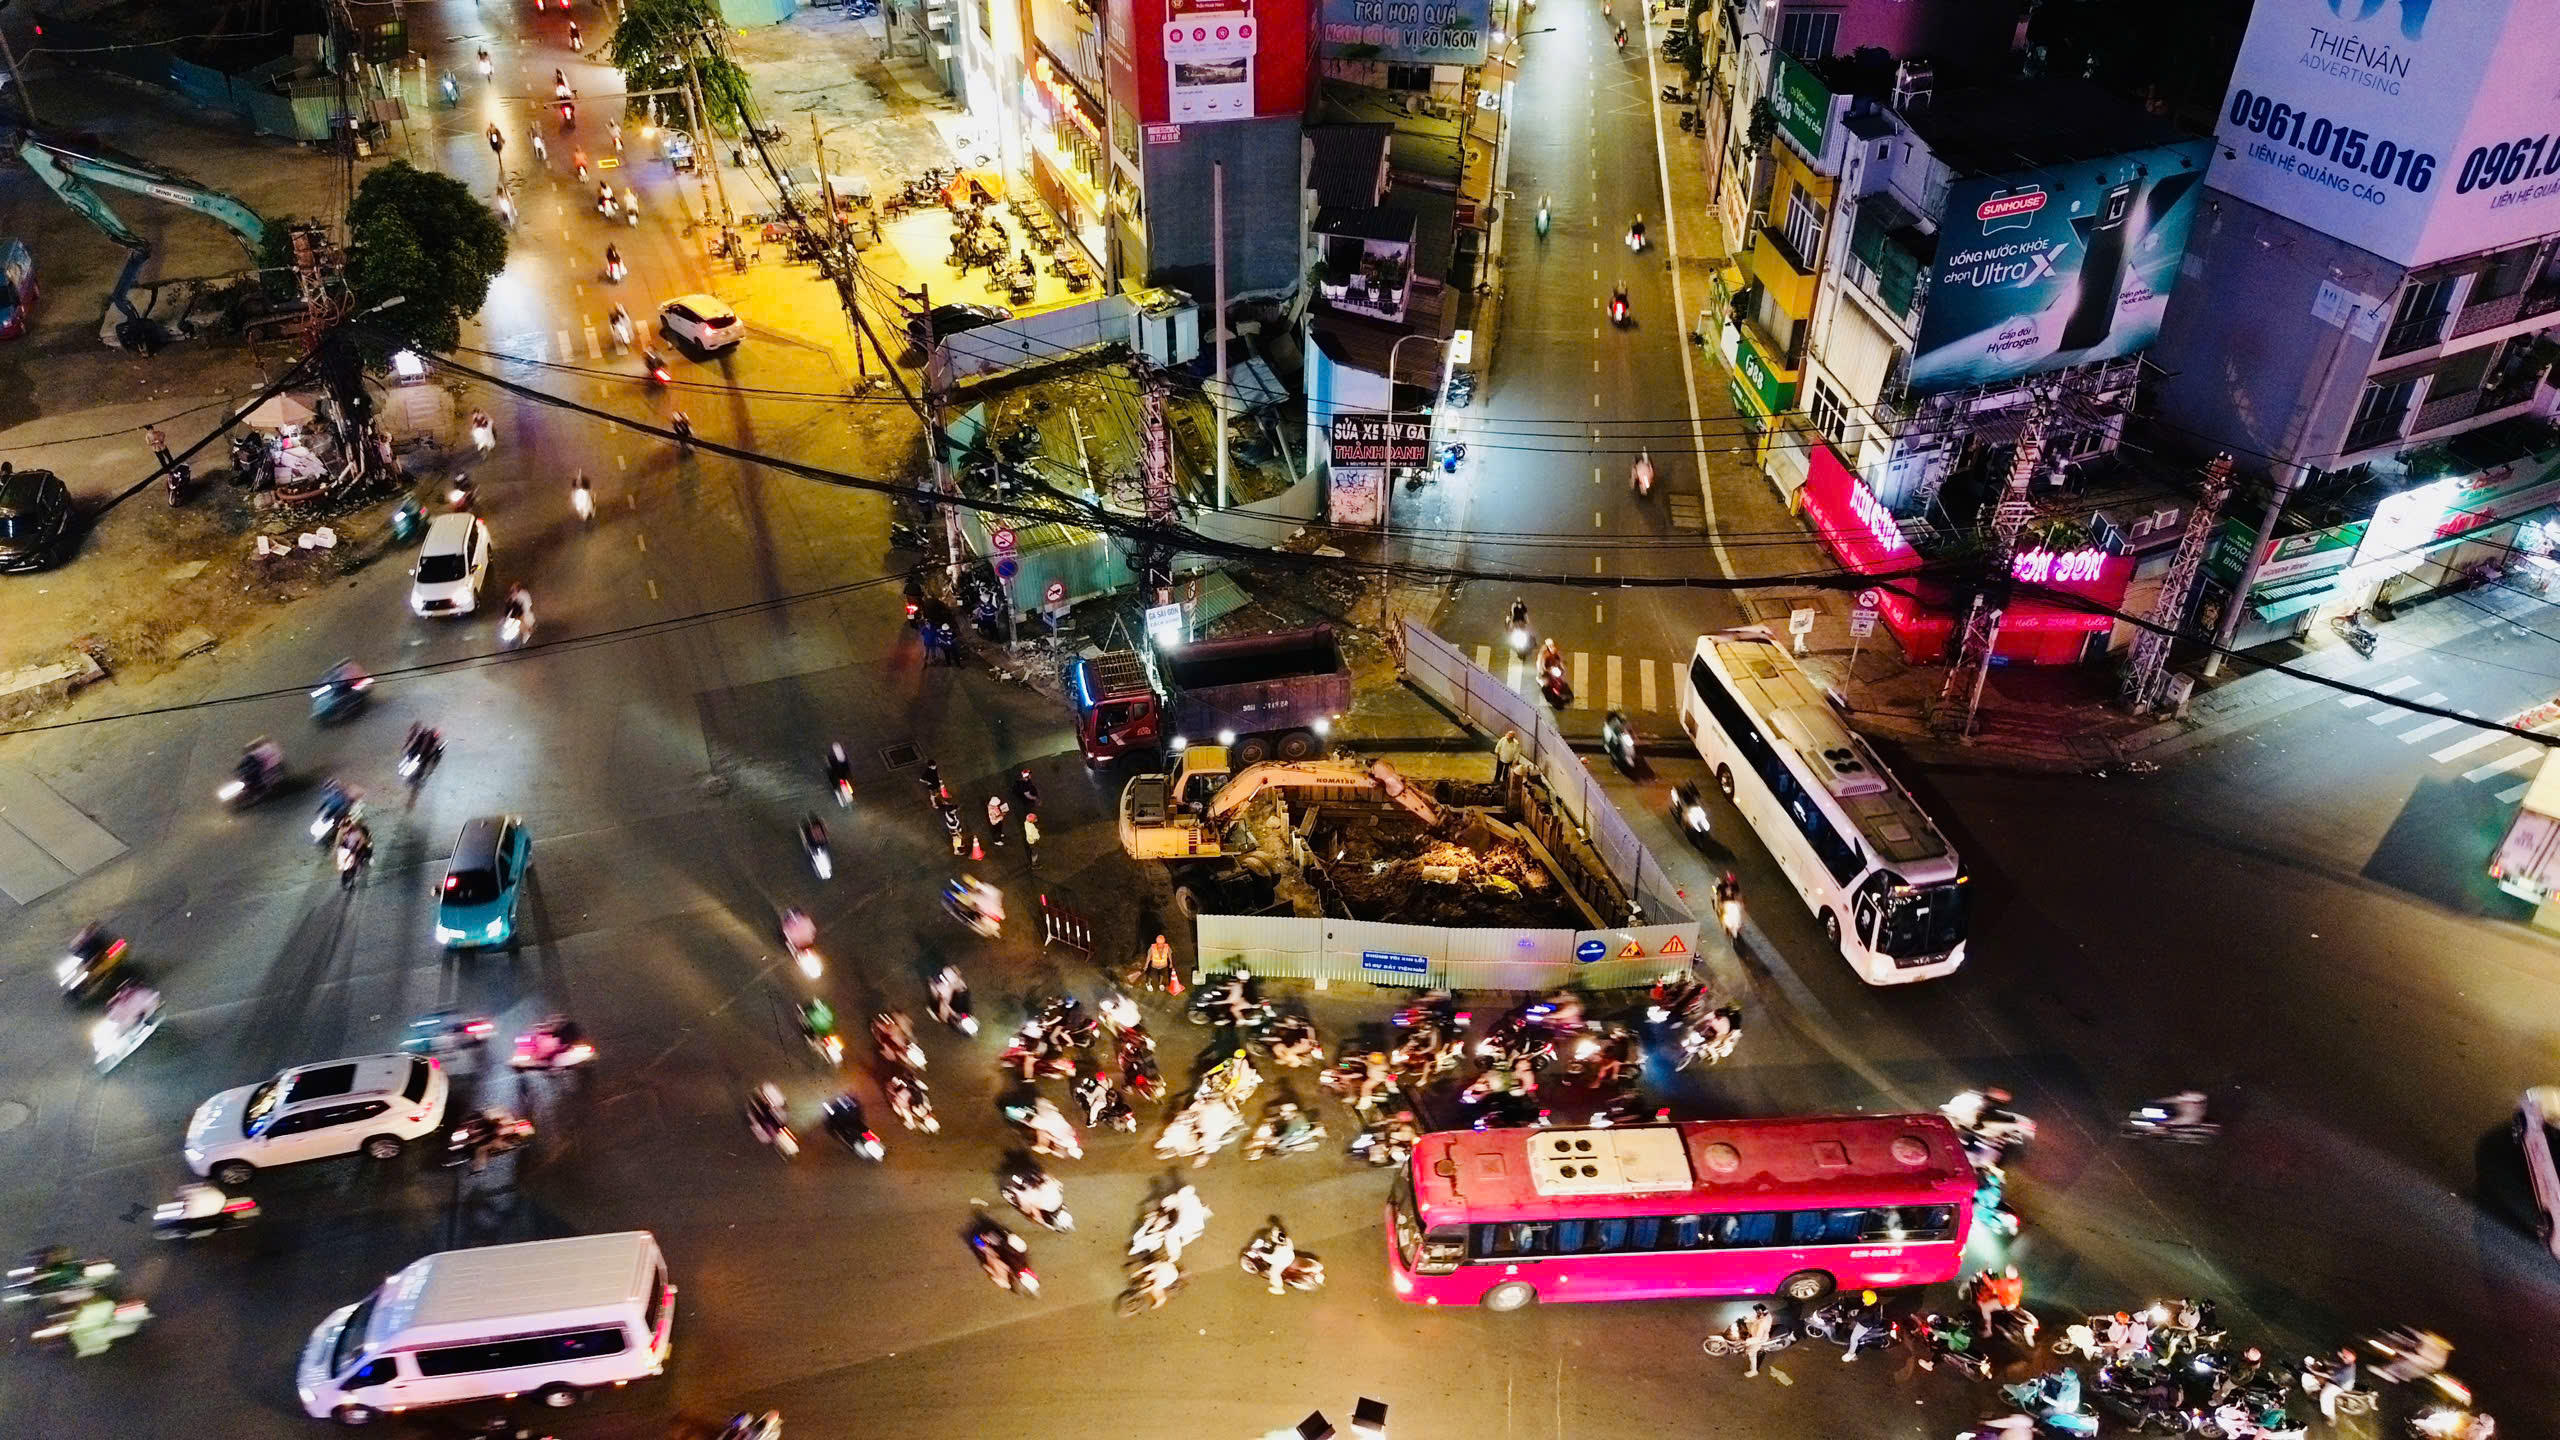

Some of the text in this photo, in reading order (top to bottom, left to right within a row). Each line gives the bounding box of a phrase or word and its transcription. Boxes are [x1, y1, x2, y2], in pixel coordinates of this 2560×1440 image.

[1389, 3, 1418, 23] HOA
[1404, 29, 1418, 49] VỊ
[1423, 26, 1438, 48] RÕ
[1443, 30, 1478, 48] NGON
[2310, 27, 2411, 78] THIÊNÂN
[2299, 53, 2401, 96] ADVERTISING
[2230, 89, 2436, 193] 0961.015.016
[2248, 143, 2386, 205] LIÊN HỆ QUẢNG CÁO
[1983, 197, 2038, 215] SUNHOUSE
[2490, 190, 2517, 209] LIÊN
[2515, 185, 2533, 203] HỆ
[1949, 237, 2049, 266] UỐNG NƯỚC KHỎE
[1944, 271, 1970, 284] chọn
[1986, 336, 2039, 353] Hydrogen
[1999, 326, 2032, 341] Gấp đôi
[1334, 417, 1359, 440] SỬA
[1362, 424, 1379, 440] XE
[1382, 424, 1404, 440] TAY
[1406, 424, 1425, 440] GA
[1385, 446, 1425, 459] DANH
[2222, 542, 2249, 563] HOND
